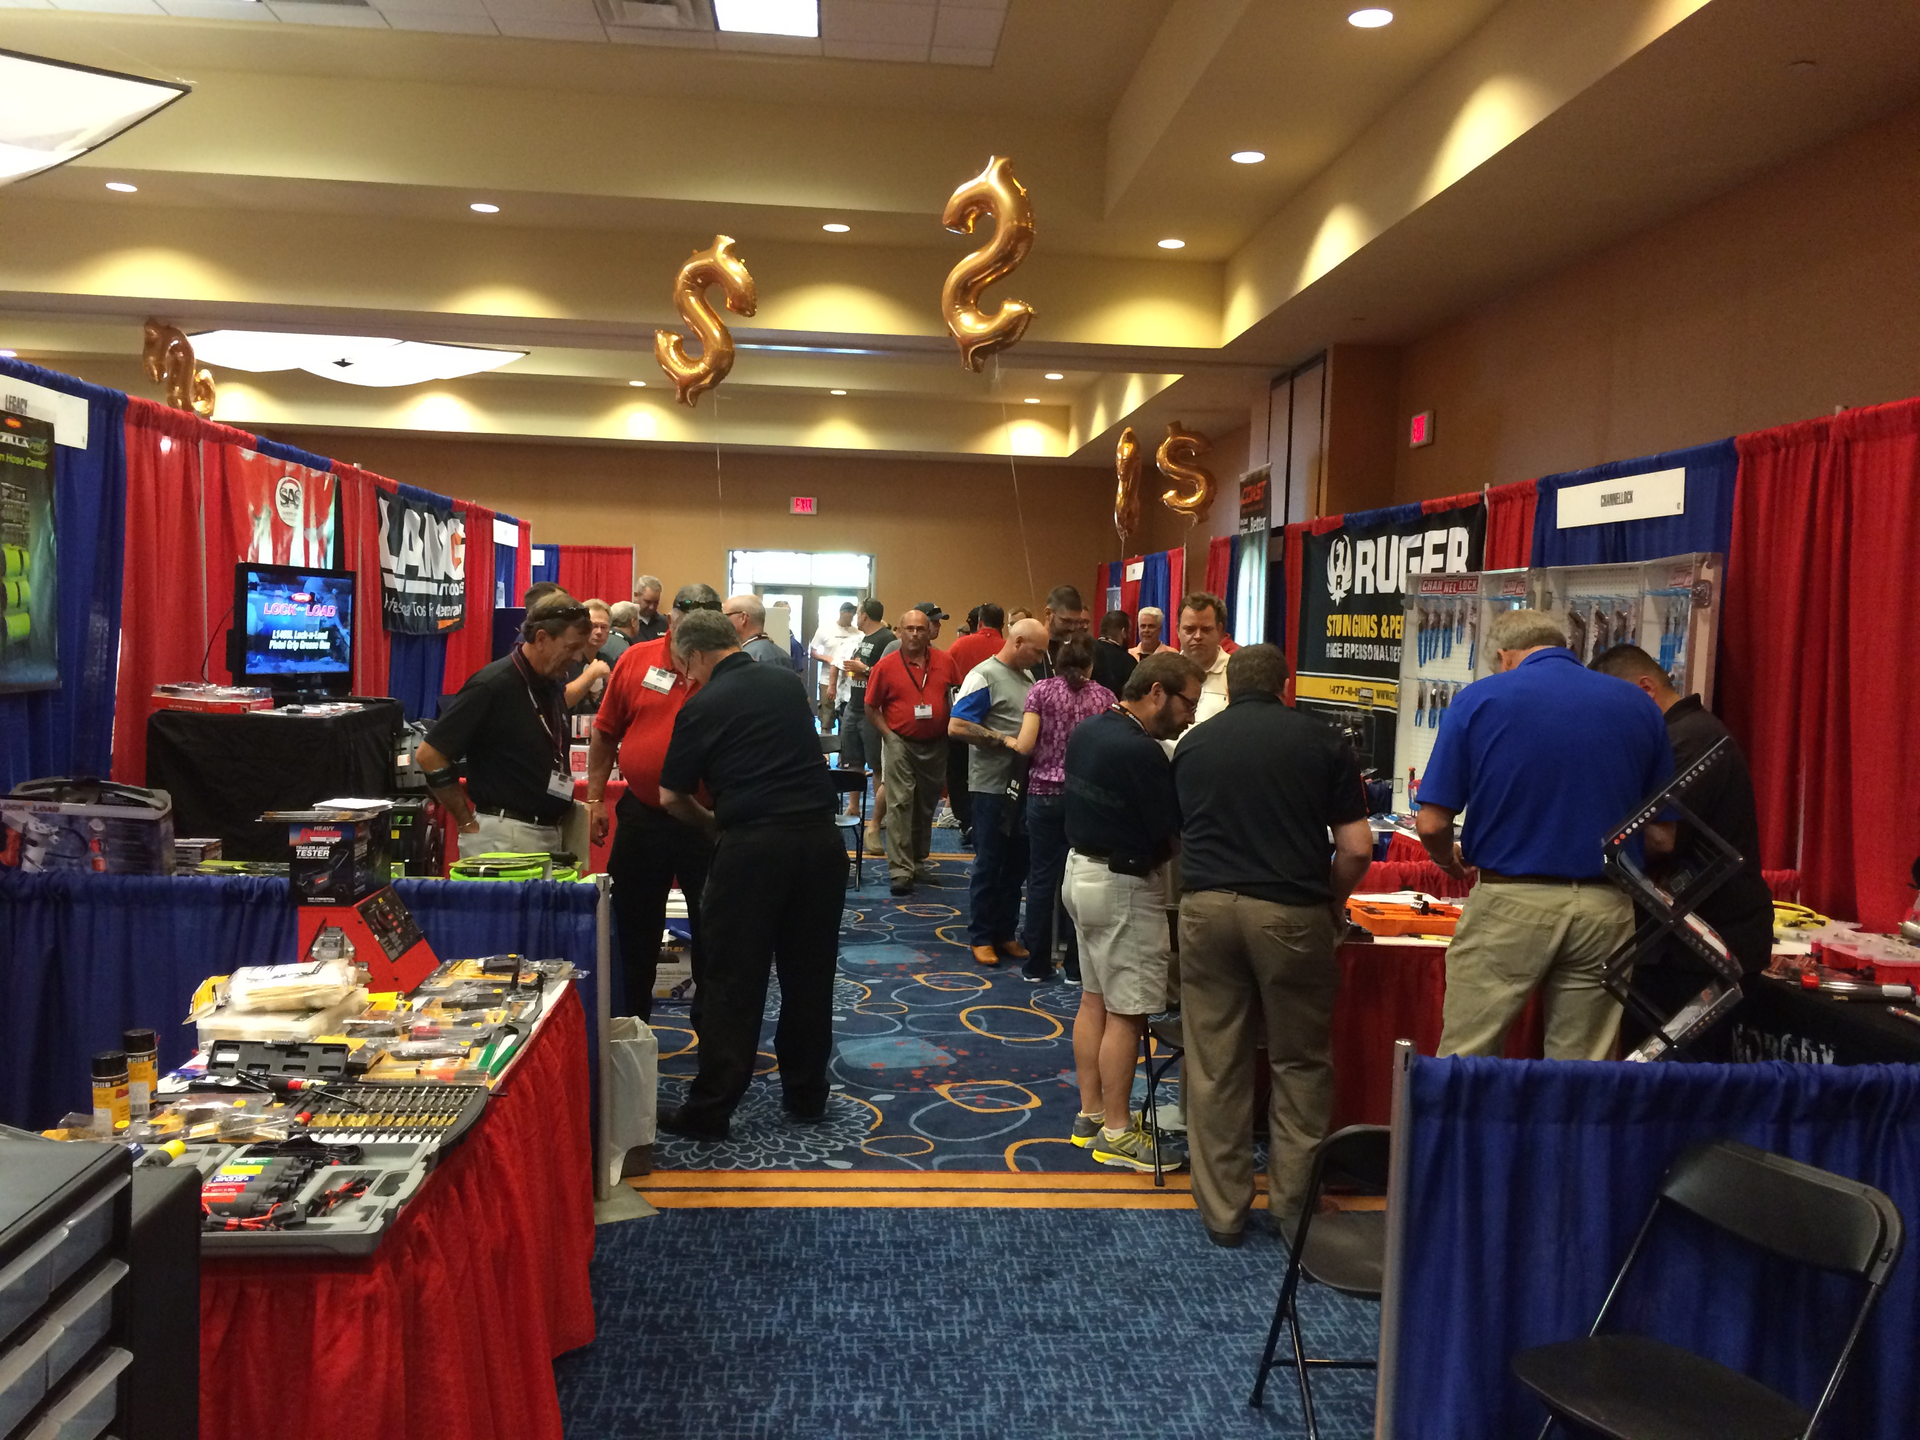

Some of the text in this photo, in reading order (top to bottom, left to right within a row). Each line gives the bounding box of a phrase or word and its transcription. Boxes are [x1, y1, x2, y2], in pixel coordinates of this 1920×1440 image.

[5, 394, 28, 415] LEGACY
[6, 453, 25, 465] Hose
[26, 456, 47, 470] Center
[795, 498, 812, 511] EXIT
[1600, 490, 1633, 507] CHANNELLOCK
[378, 496, 466, 580] LANG
[1354, 527, 1469, 595] RUGER
[1352, 614, 1378, 638] GUNS
